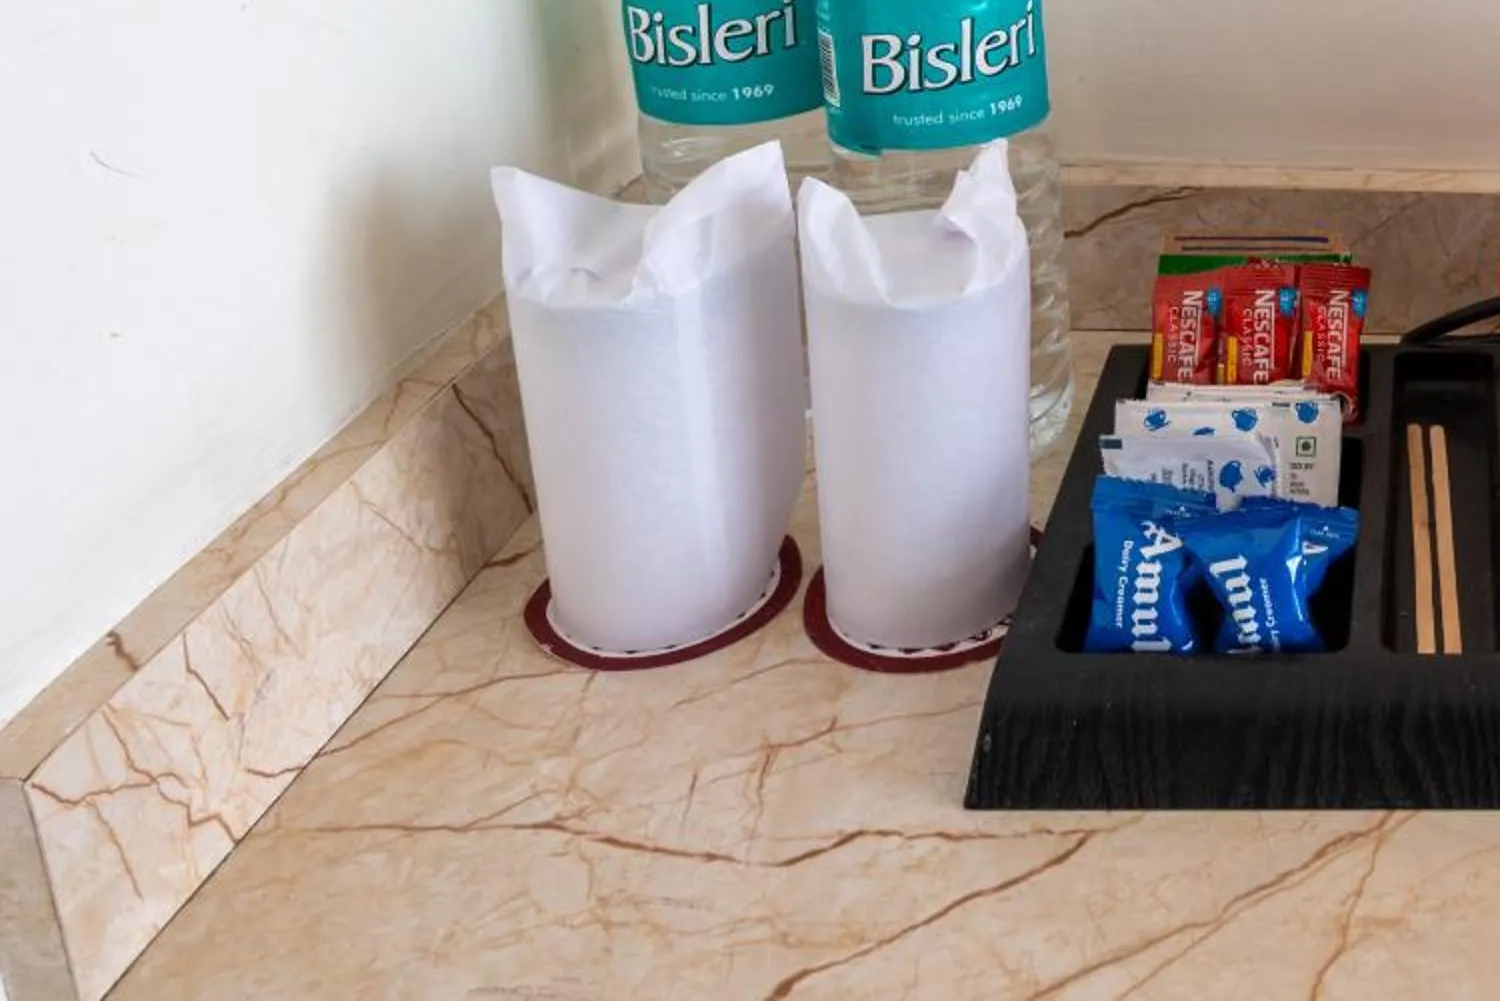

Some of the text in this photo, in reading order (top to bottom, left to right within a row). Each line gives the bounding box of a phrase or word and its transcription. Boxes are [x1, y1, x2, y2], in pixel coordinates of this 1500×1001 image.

[860, 0, 1038, 95] Bisleri
[732, 84, 774, 100] 1969
[893, 94, 1023, 126] trusted since 1969
[1115, 575, 1129, 628] Creamer
[1131, 521, 1183, 652] Amul
[1209, 554, 1263, 653] mul
